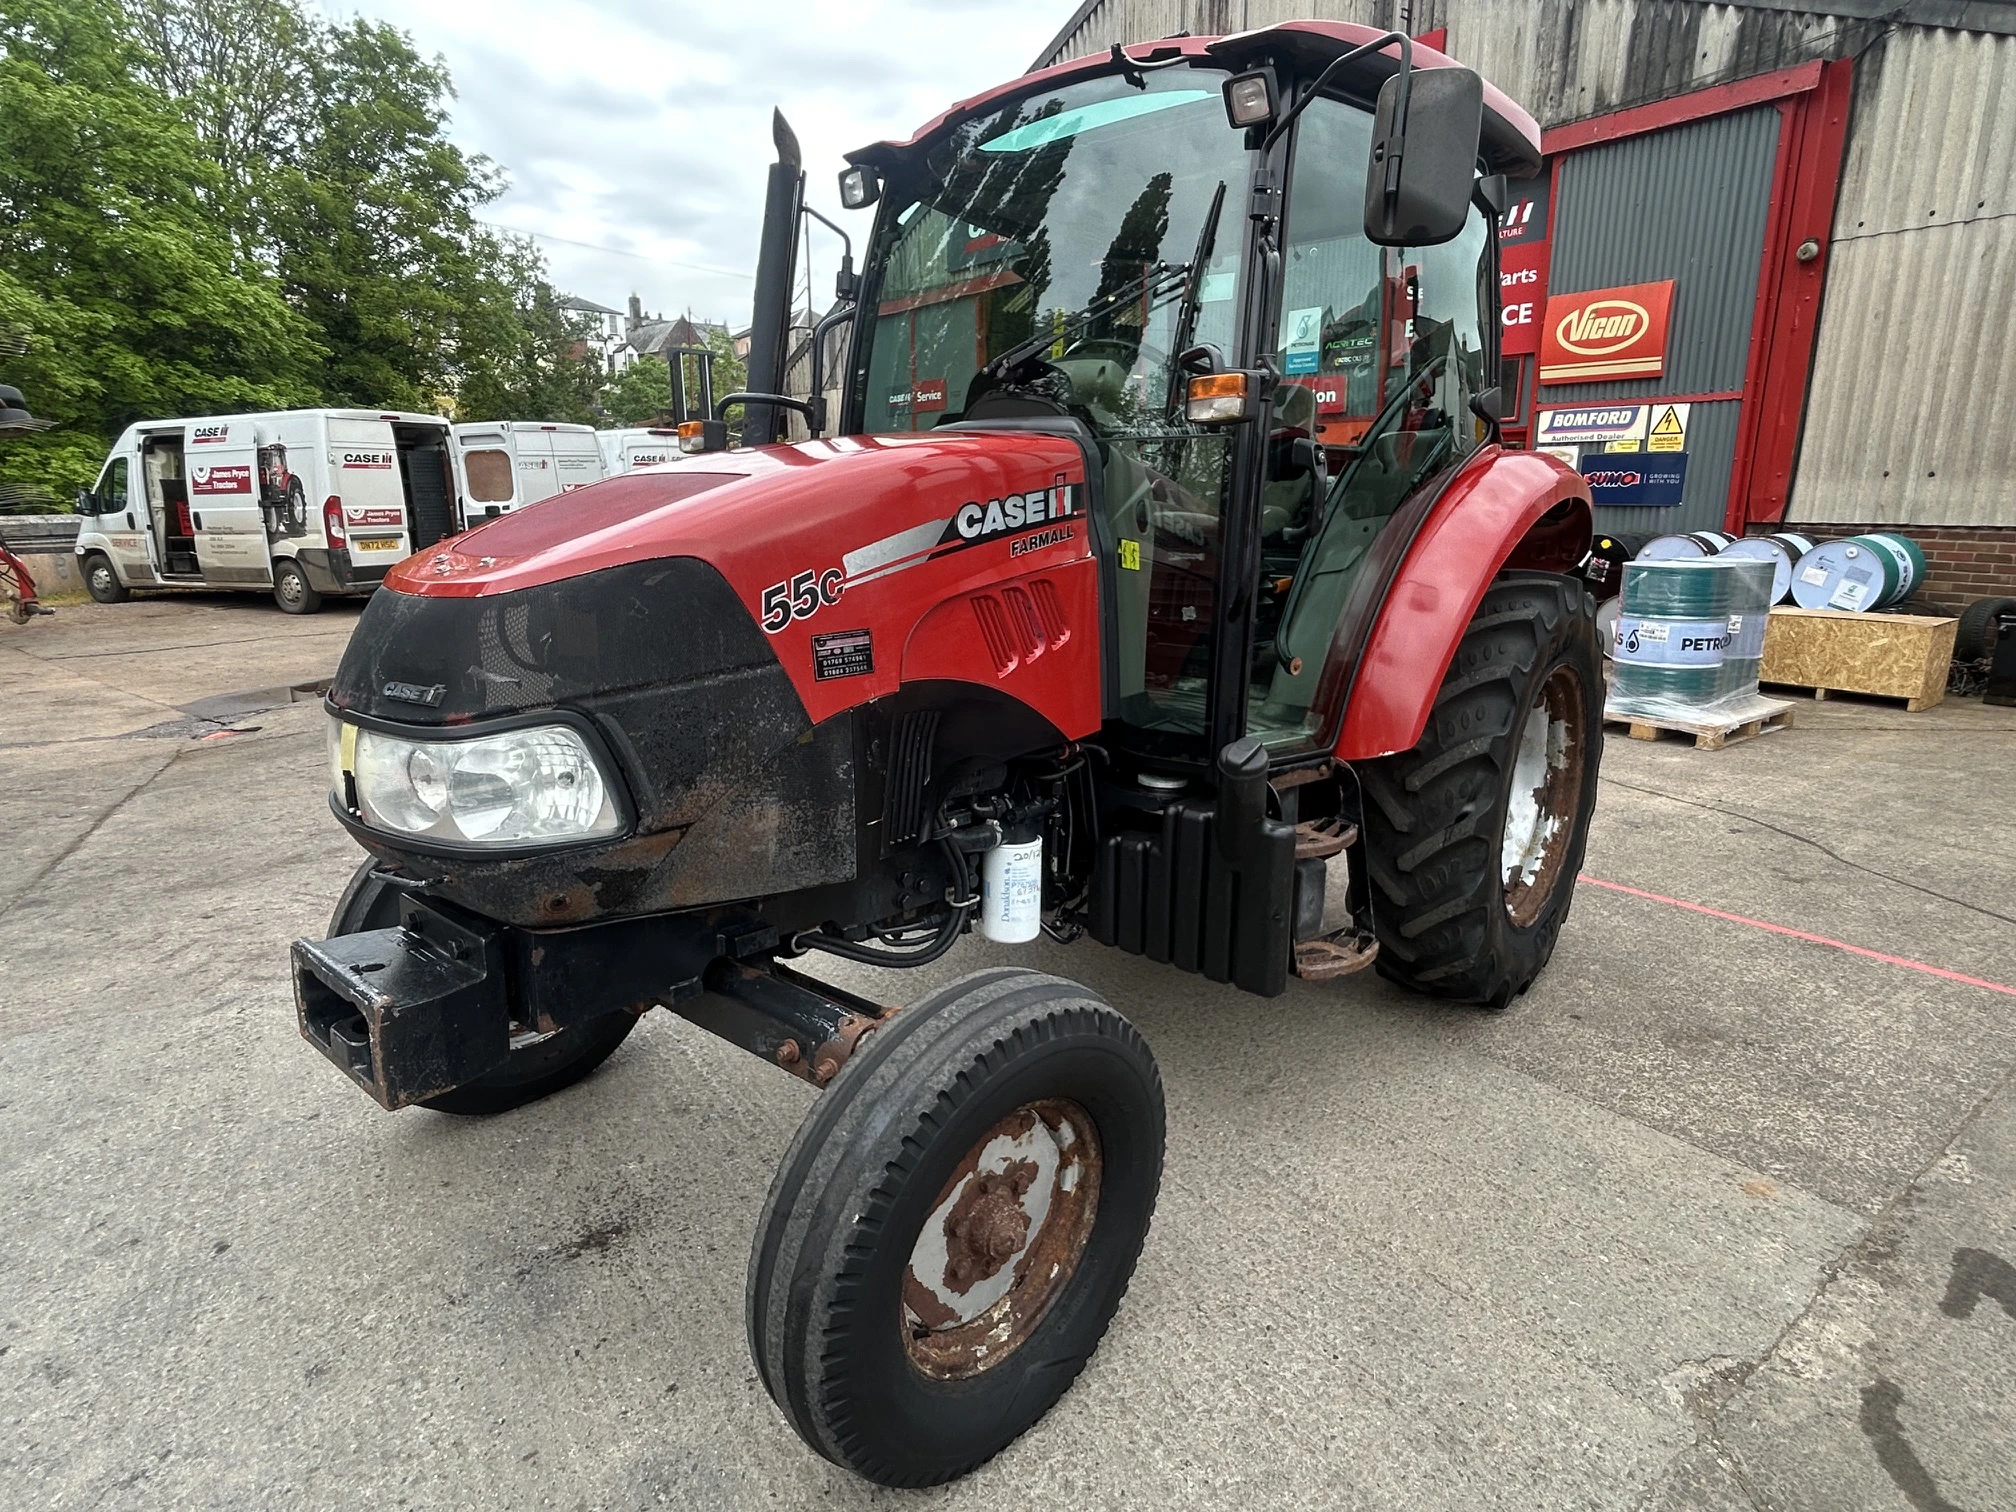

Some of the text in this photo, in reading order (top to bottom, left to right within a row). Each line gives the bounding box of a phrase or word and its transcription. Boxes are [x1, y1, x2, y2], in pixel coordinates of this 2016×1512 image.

[1500, 268, 1537, 286] arts
[1569, 309, 1637, 342] Vicon
[917, 391, 942, 402] Service
[1552, 410, 1632, 428] BOMFORD
[194, 427, 220, 437] CASE
[1551, 434, 1595, 442] Authorised
[344, 453, 380, 463] CASE
[518, 461, 538, 470] ASE
[212, 469, 250, 479] James Pryce
[1587, 471, 1637, 488] SUMO
[212, 481, 238, 489] Tractors
[956, 491, 1047, 539] CASE
[112, 538, 138, 547] SERVICE
[1010, 525, 1074, 557] FARMALL
[761, 567, 845, 634] 55C
[383, 681, 420, 699] CASE
